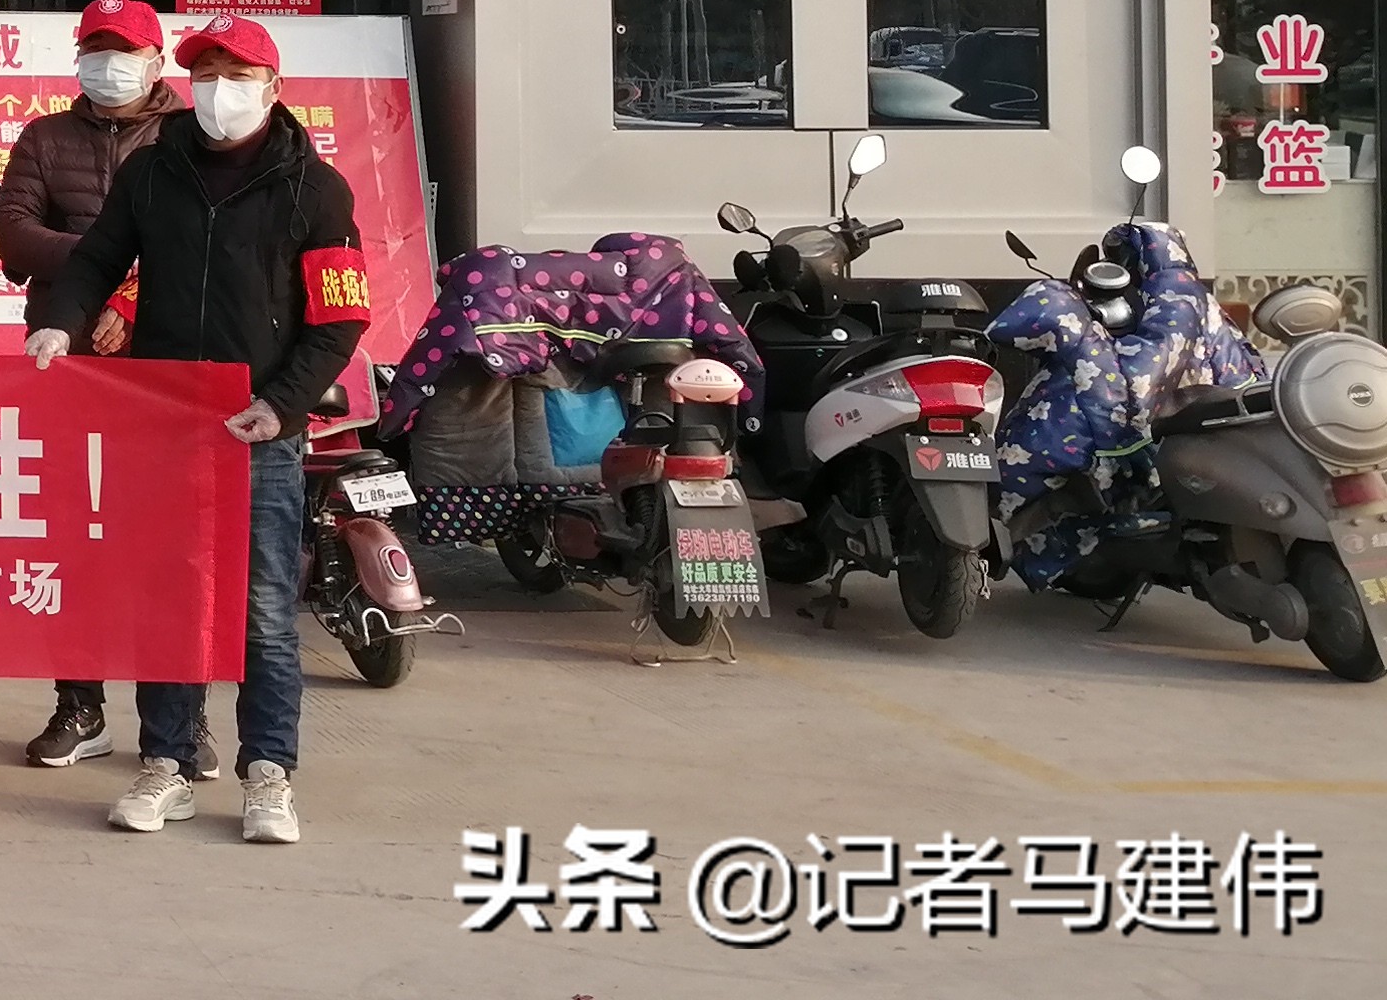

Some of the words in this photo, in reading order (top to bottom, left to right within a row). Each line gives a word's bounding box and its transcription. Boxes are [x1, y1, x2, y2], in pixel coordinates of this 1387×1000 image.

[921, 283, 962, 297] 雅迪
[946, 452, 992, 469] 雅迪
[680, 561, 758, 584] 好品质更安全
